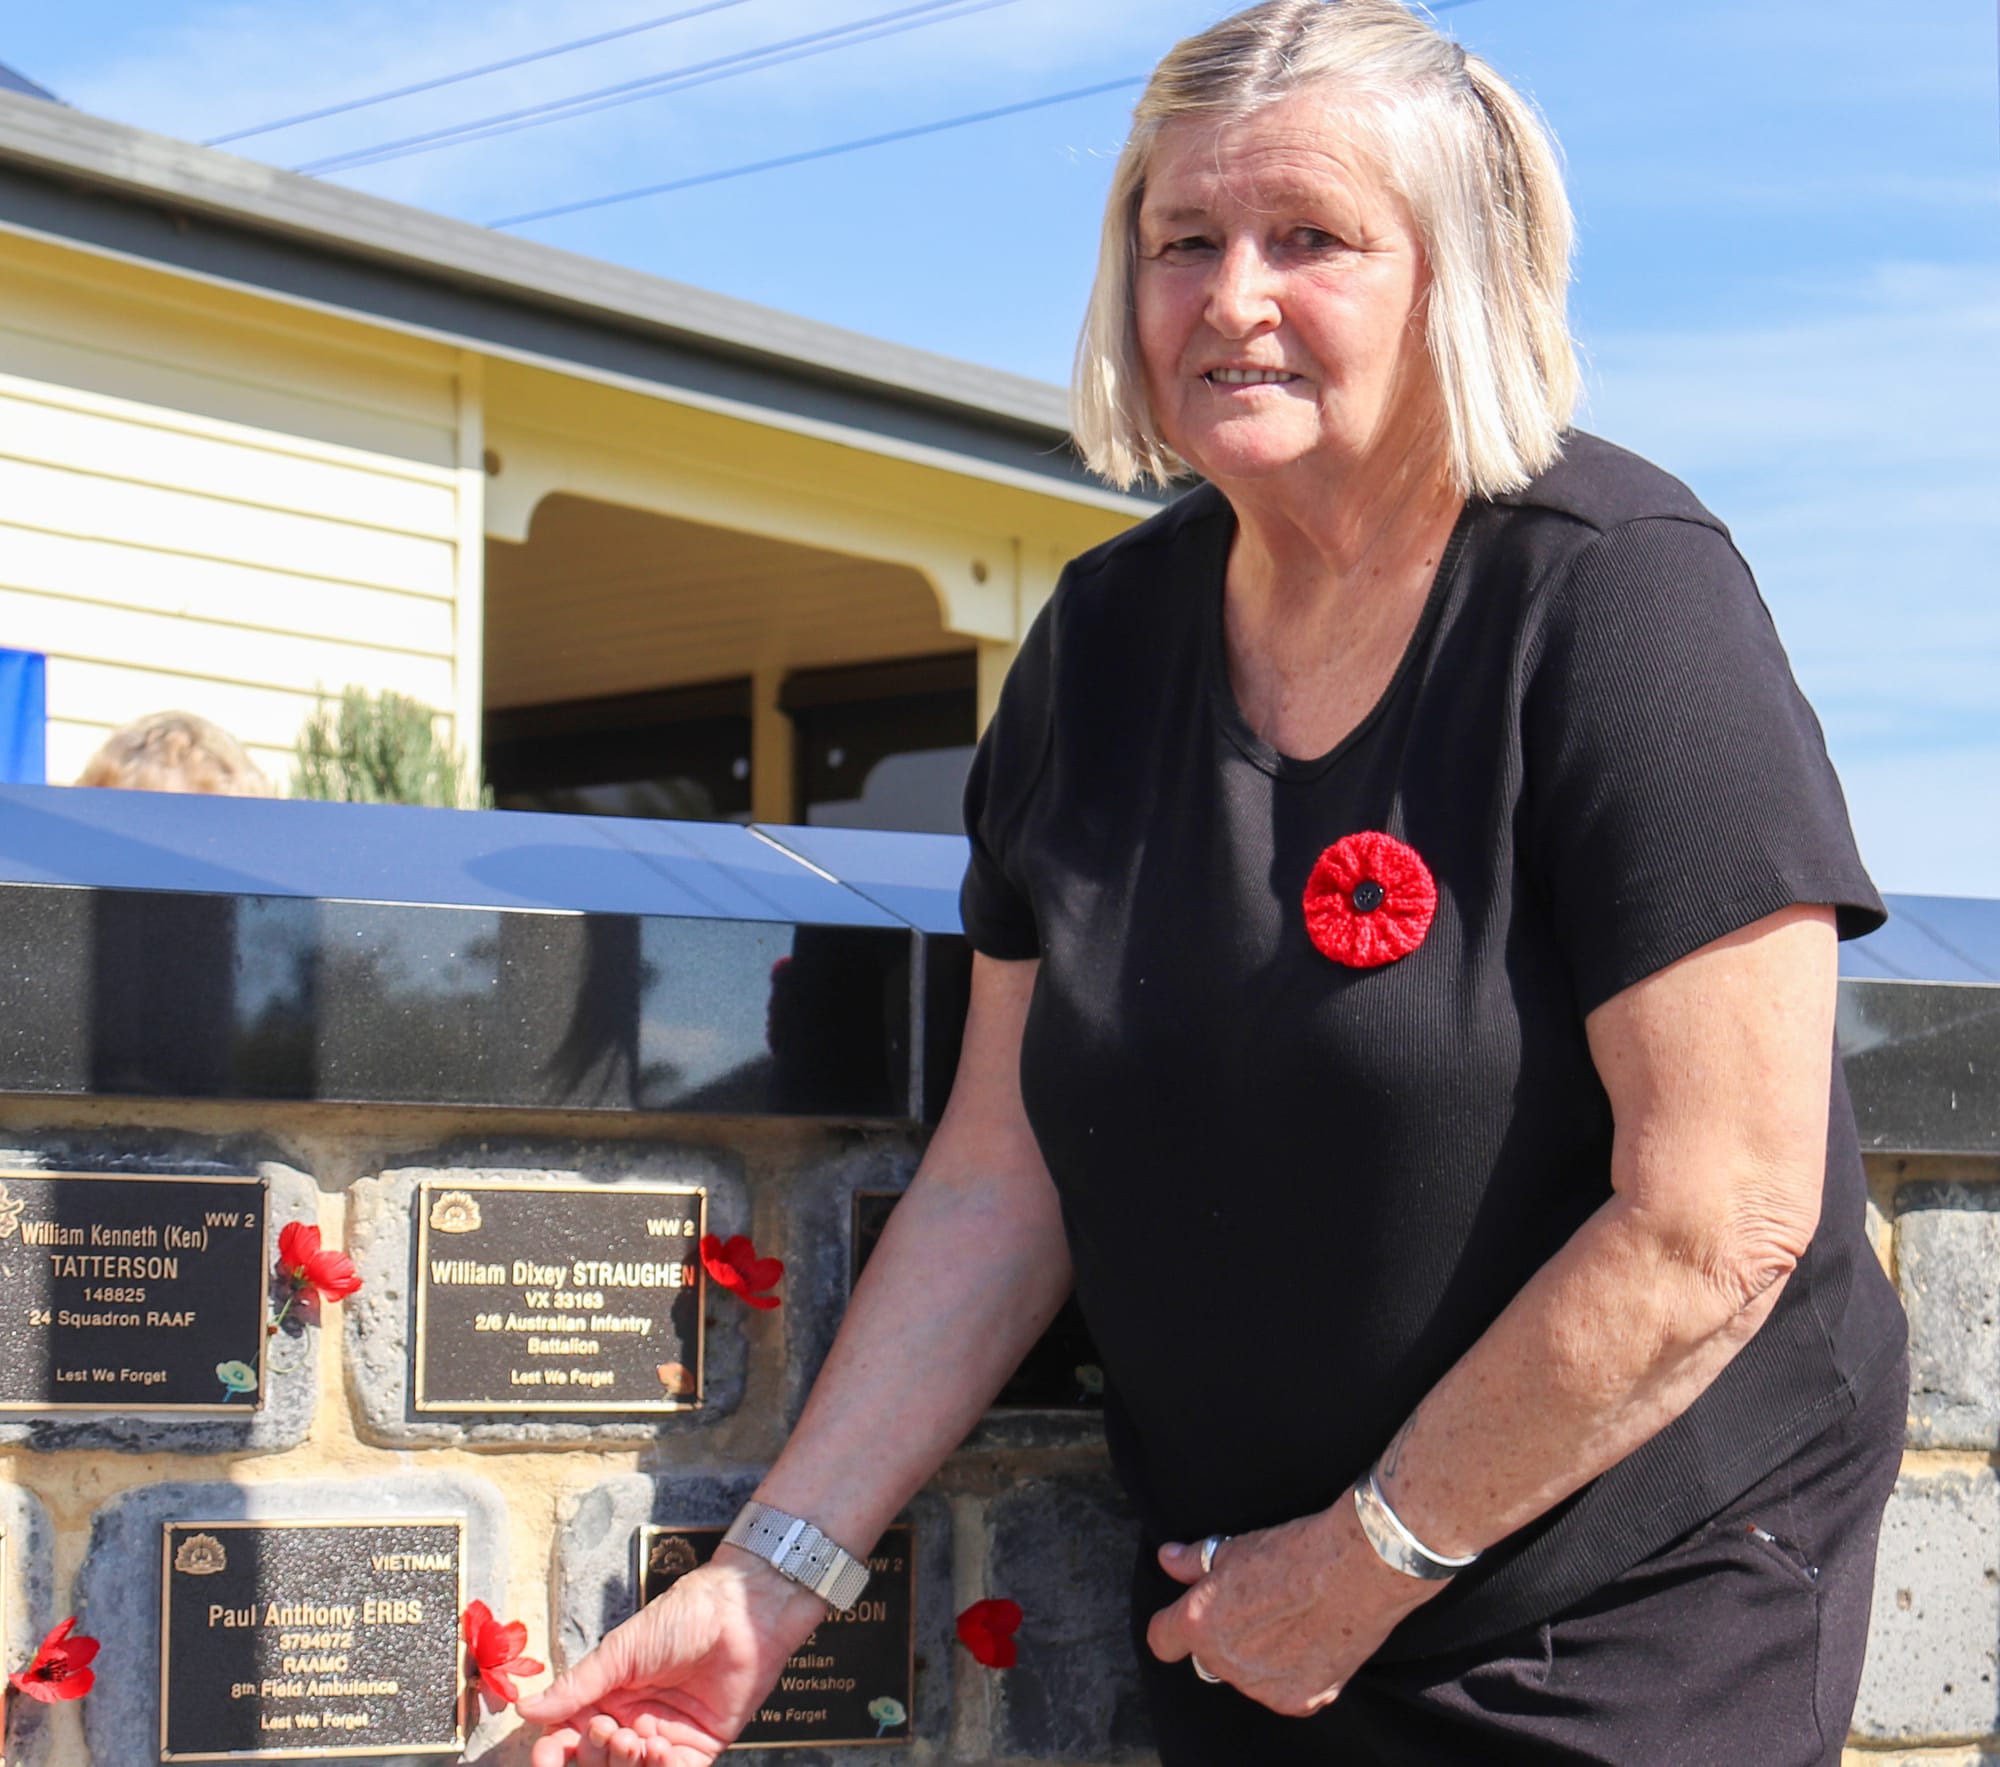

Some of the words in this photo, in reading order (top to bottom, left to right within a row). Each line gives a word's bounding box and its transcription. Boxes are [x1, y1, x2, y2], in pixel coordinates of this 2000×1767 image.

[205, 1211, 240, 1228] WW
[244, 1212, 256, 1229] 2
[646, 1218, 680, 1237] WW
[682, 1219, 695, 1237] 2
[21, 1221, 84, 1246] William
[91, 1223, 157, 1248] Kenneth
[164, 1224, 209, 1252] (Ken)
[50, 1254, 179, 1280] TATTERSON
[430, 1260, 506, 1286] William
[512, 1261, 567, 1289] Dixey
[573, 1262, 695, 1288] STRAUGHEN
[525, 1291, 550, 1309] VX
[57, 1311, 140, 1329] Squadron
[146, 1311, 196, 1328] RAAF
[504, 1312, 587, 1333] Australian
[590, 1314, 652, 1336] Infantry
[527, 1336, 600, 1355] Battalion
[56, 1368, 88, 1383] Lest
[92, 1369, 115, 1383] We
[120, 1369, 168, 1386] Forget
[510, 1369, 542, 1385] Lest
[544, 1369, 568, 1385] We
[569, 1369, 616, 1388] Forget
[371, 1554, 452, 1572] VIETNAM
[208, 1603, 257, 1628] Paul
[263, 1602, 356, 1629] Anthony
[362, 1600, 423, 1625] ERBS
[282, 1655, 349, 1674] RAAMC
[231, 1682, 257, 1699] 8th
[260, 1679, 302, 1698] Field
[305, 1678, 399, 1697] Ambulance
[781, 1675, 856, 1692] Workshop
[259, 1713, 292, 1730] Lest
[294, 1713, 319, 1729] We
[322, 1711, 369, 1731] Forget
[760, 1708, 782, 1722] We
[785, 1706, 828, 1724] Forget
